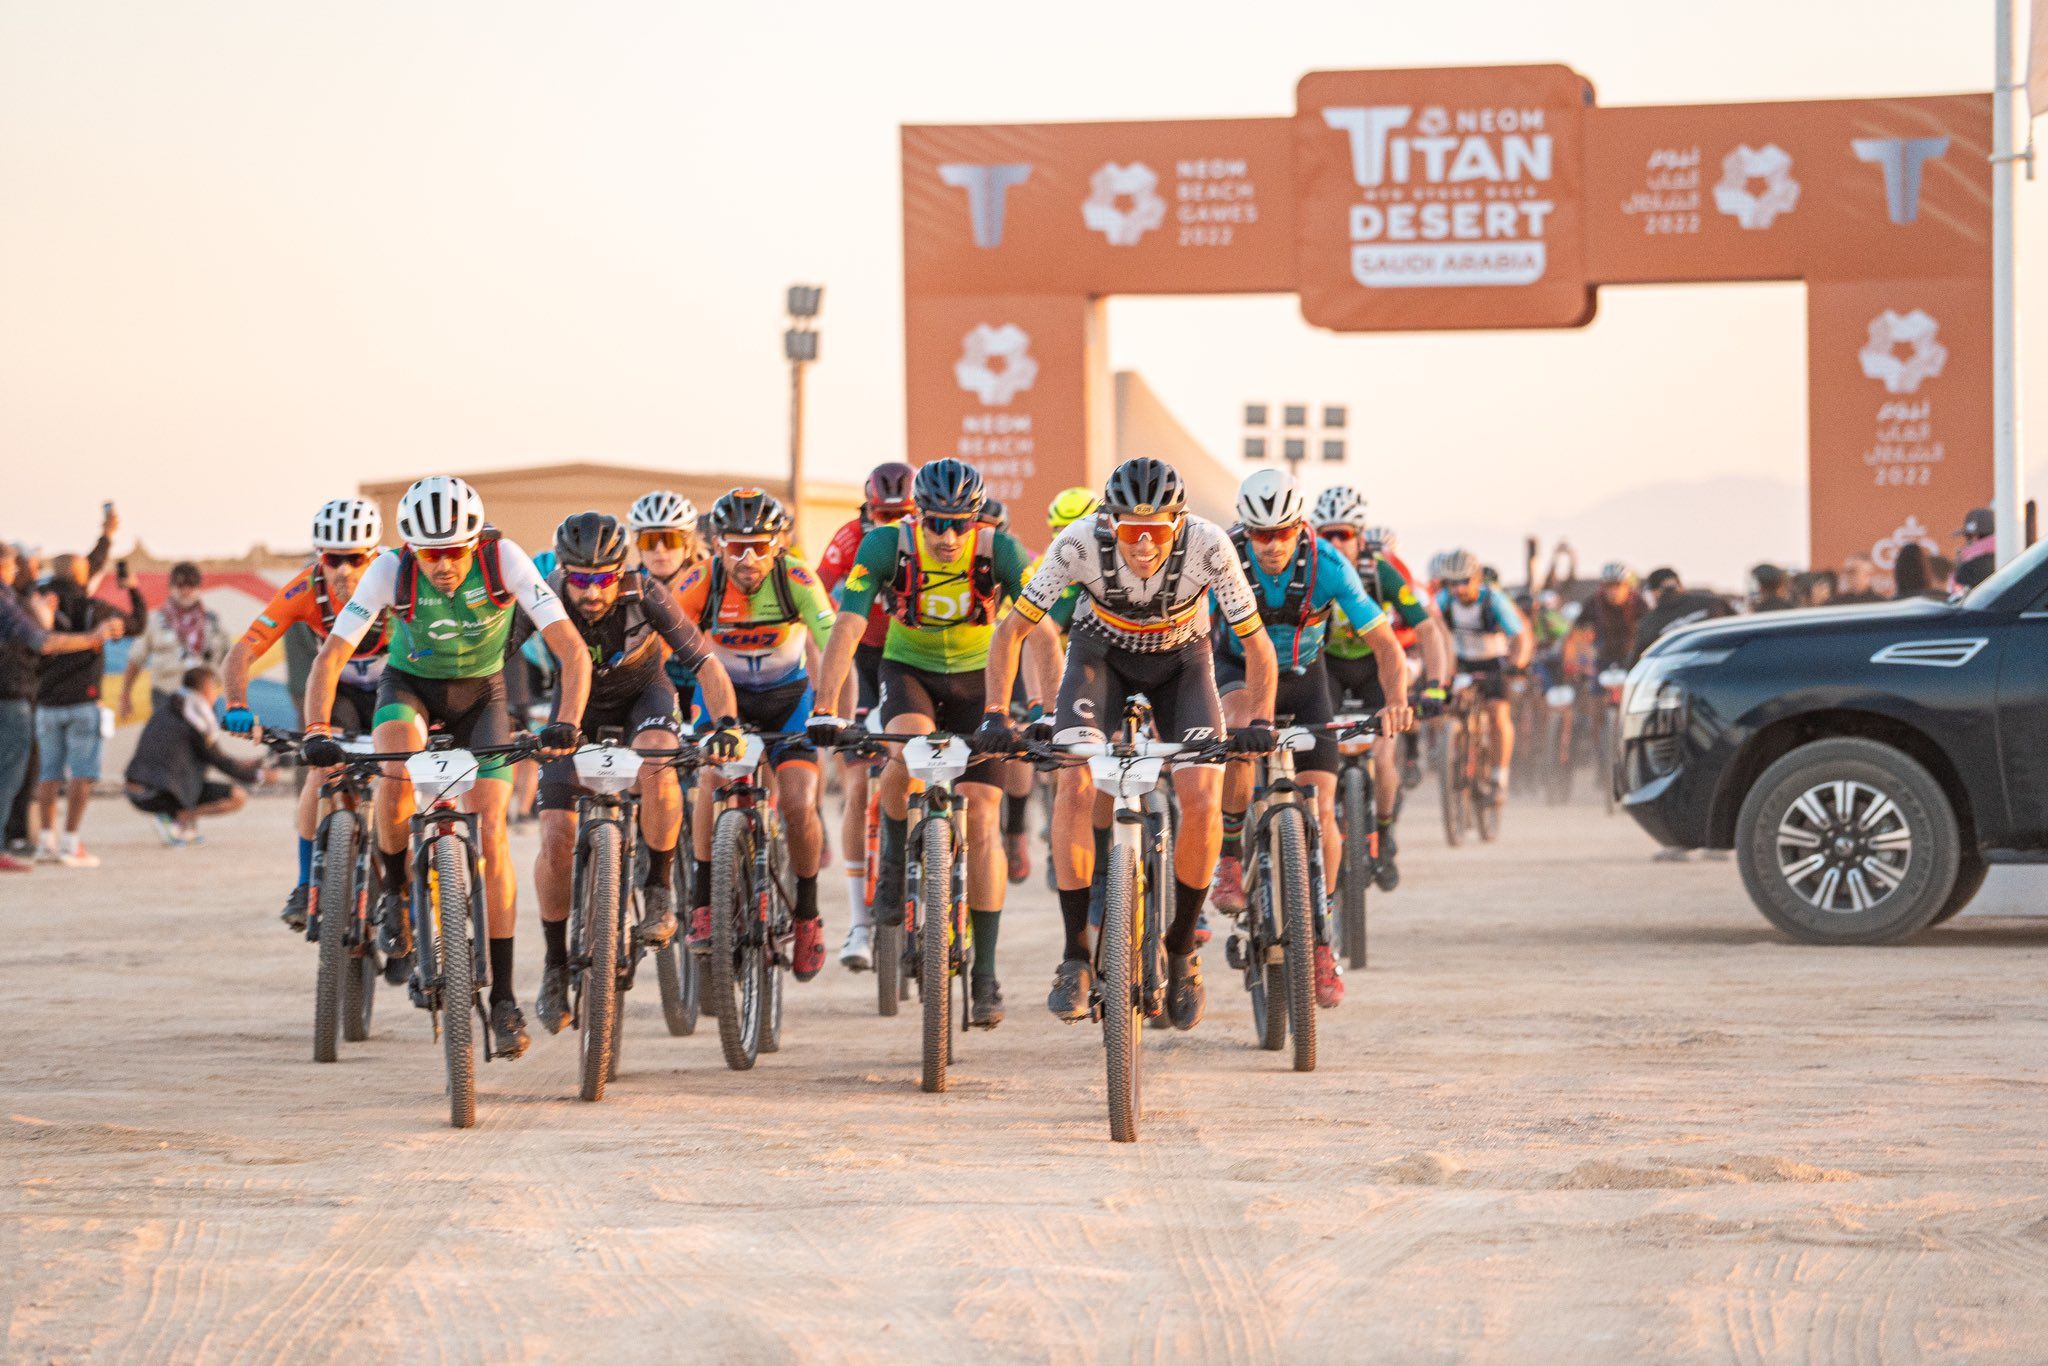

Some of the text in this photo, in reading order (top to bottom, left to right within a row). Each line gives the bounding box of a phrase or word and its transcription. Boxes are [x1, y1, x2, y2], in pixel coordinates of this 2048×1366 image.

[1456, 109, 1545, 132] NEOM
[1321, 105, 1553, 187] TITAN
[1176, 159, 1247, 178] NEOM
[1177, 183, 1254, 201] BEACH
[1178, 204, 1258, 224] GAMES
[1350, 200, 1555, 241] DESERT
[1645, 214, 1700, 235] 2022
[1178, 226, 1234, 247] 2022
[1360, 252, 1538, 274] SAUDI ARABIA
[962, 414, 1032, 433] NEOM
[957, 437, 1034, 456] BEACH
[970, 459, 1035, 478] AMES
[721, 632, 779, 646] KH7
[436, 760, 449, 773] 7
[601, 754, 613, 768] 3
